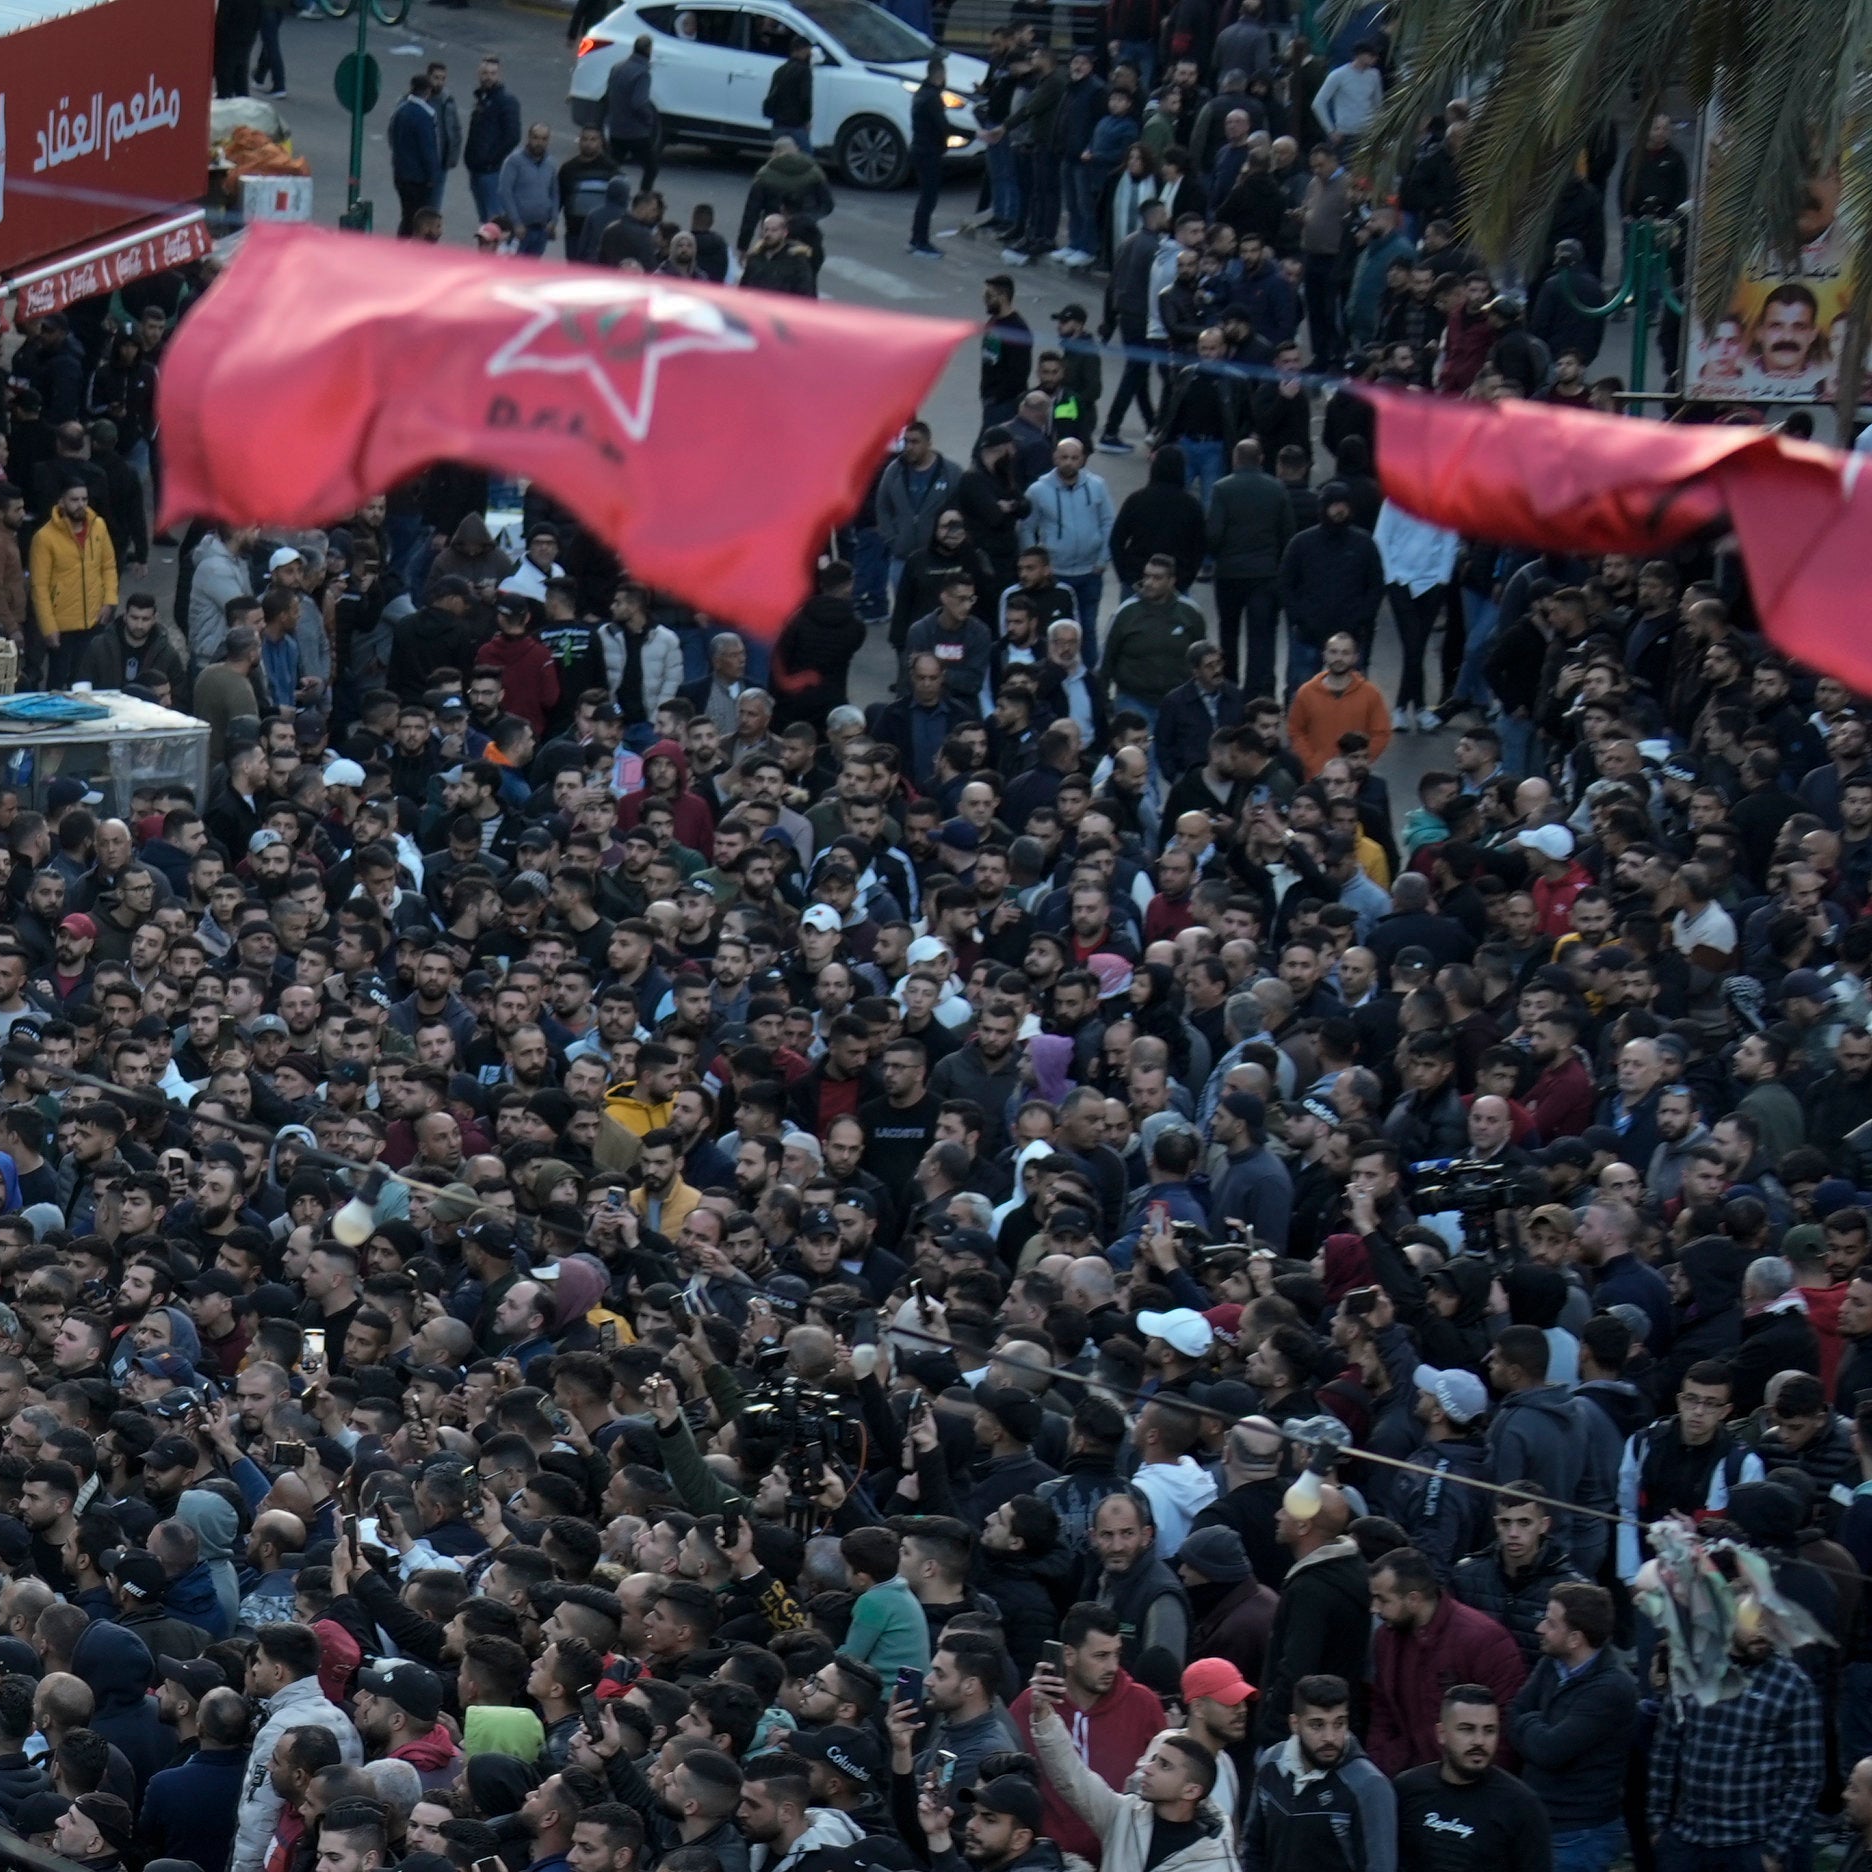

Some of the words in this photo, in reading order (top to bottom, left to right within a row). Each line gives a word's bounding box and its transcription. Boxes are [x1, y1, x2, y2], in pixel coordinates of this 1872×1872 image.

[33, 93, 103, 173] العقاد
[104, 74, 181, 161] مطعم
[1423, 1811, 1476, 1839] Replay
